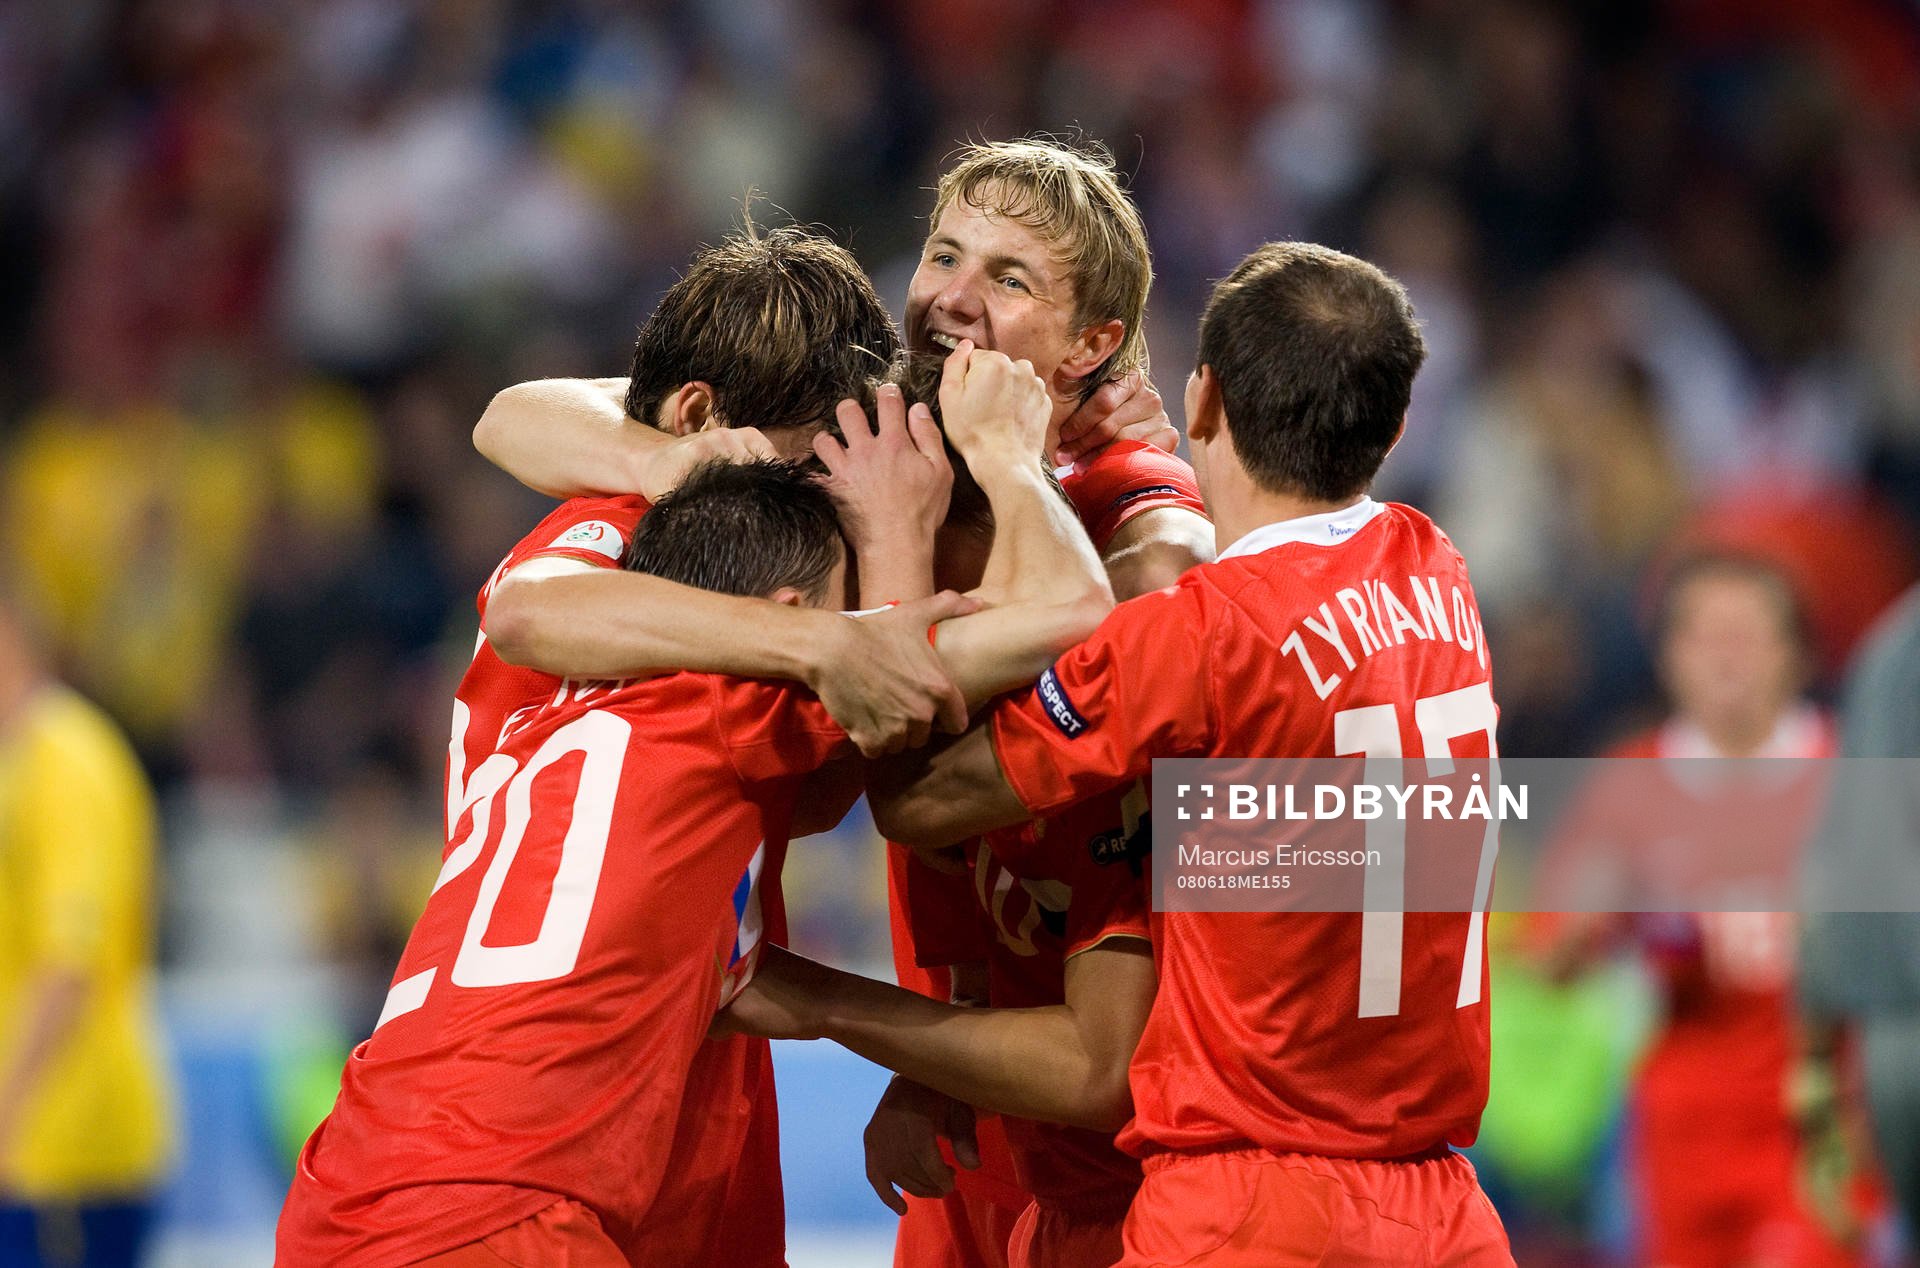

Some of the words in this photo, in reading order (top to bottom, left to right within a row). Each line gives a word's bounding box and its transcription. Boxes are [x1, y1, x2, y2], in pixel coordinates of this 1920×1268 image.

[1040, 668, 1082, 732] ESPECT
[1280, 576, 1485, 700] ZYRYANOV
[1334, 681, 1501, 1019] 17
